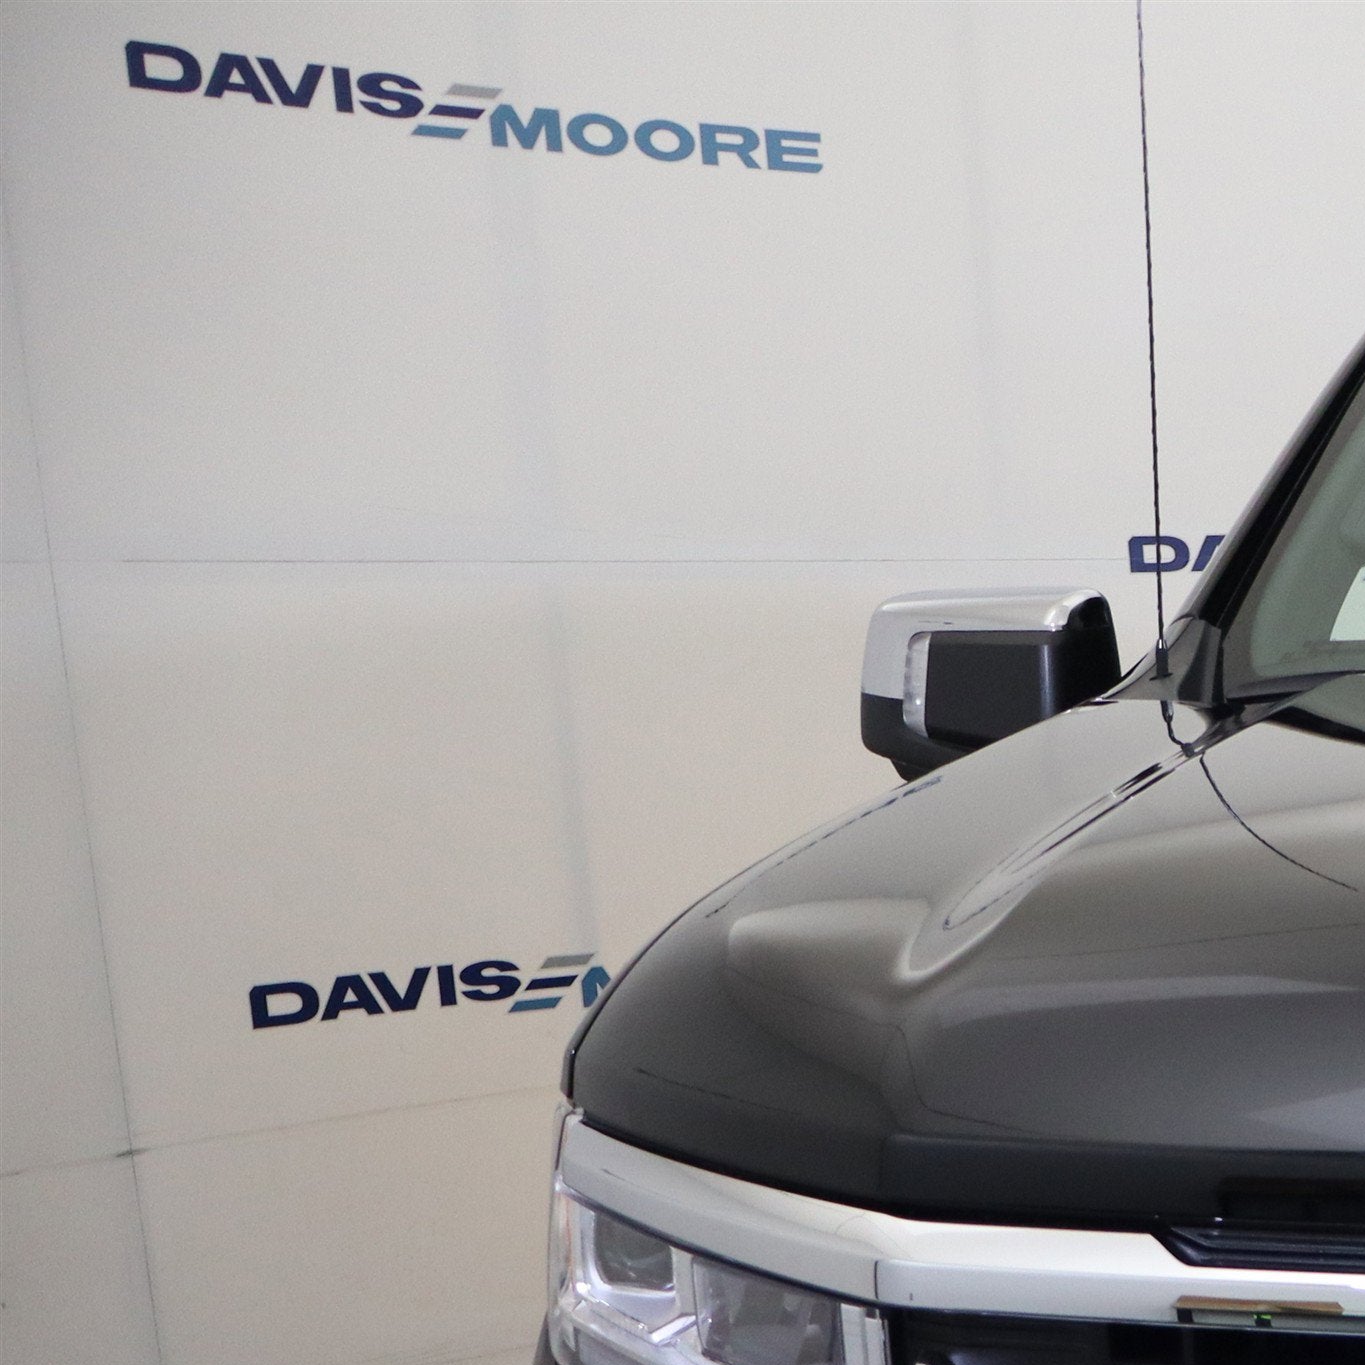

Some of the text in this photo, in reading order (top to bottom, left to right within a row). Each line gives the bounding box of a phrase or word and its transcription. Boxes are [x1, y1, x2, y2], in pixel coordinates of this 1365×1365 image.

[125, 40, 824, 175] DAVIS MOORE
[248, 960, 522, 1030] DAVIS
